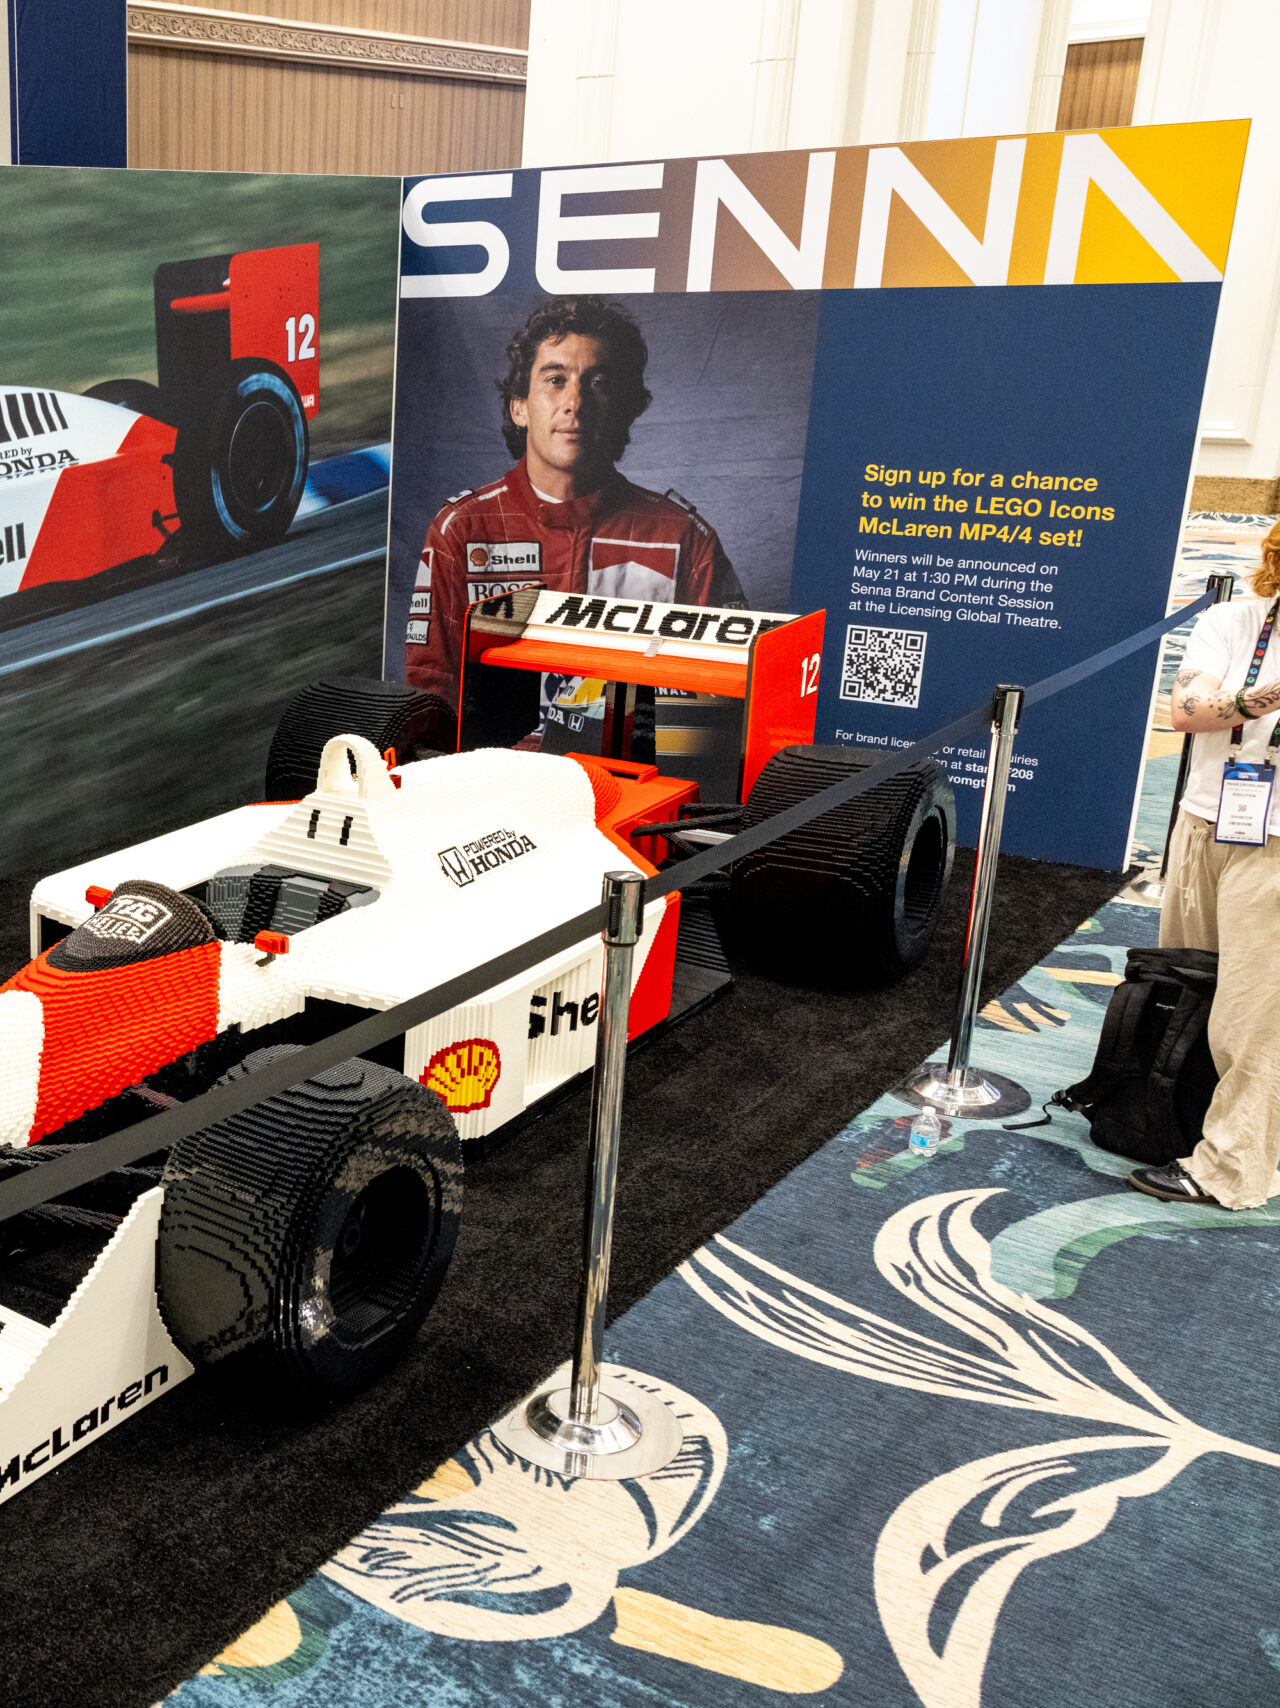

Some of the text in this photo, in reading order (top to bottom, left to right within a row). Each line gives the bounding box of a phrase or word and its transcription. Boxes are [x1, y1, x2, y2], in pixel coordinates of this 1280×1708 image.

[400, 133, 1223, 298] SENNA
[285, 313, 315, 362] 12
[20, 447, 32, 456] by
[864, 464, 1098, 492] Sign up for a chance
[861, 491, 1115, 521] to win the LEGO Icons
[858, 516, 1083, 547] McLaren MP4/4 set!
[491, 554, 536, 565] Shell
[855, 549, 1058, 575] Winners will be announced on
[853, 566, 1053, 593] May 21 at 1:30 PM during the
[851, 582, 1054, 610] Senna Brand Content Session
[849, 600, 1062, 630] at the Licensing Global Theatre.
[800, 652, 821, 698] 12
[835, 729, 854, 741] For
[856, 734, 888, 747] brand
[943, 745, 956, 755] or
[958, 747, 986, 759] retail
[951, 761, 962, 770] at
[463, 828, 517, 857] POWERED by
[469, 835, 537, 876] HONDA
[528, 990, 599, 1039] She
